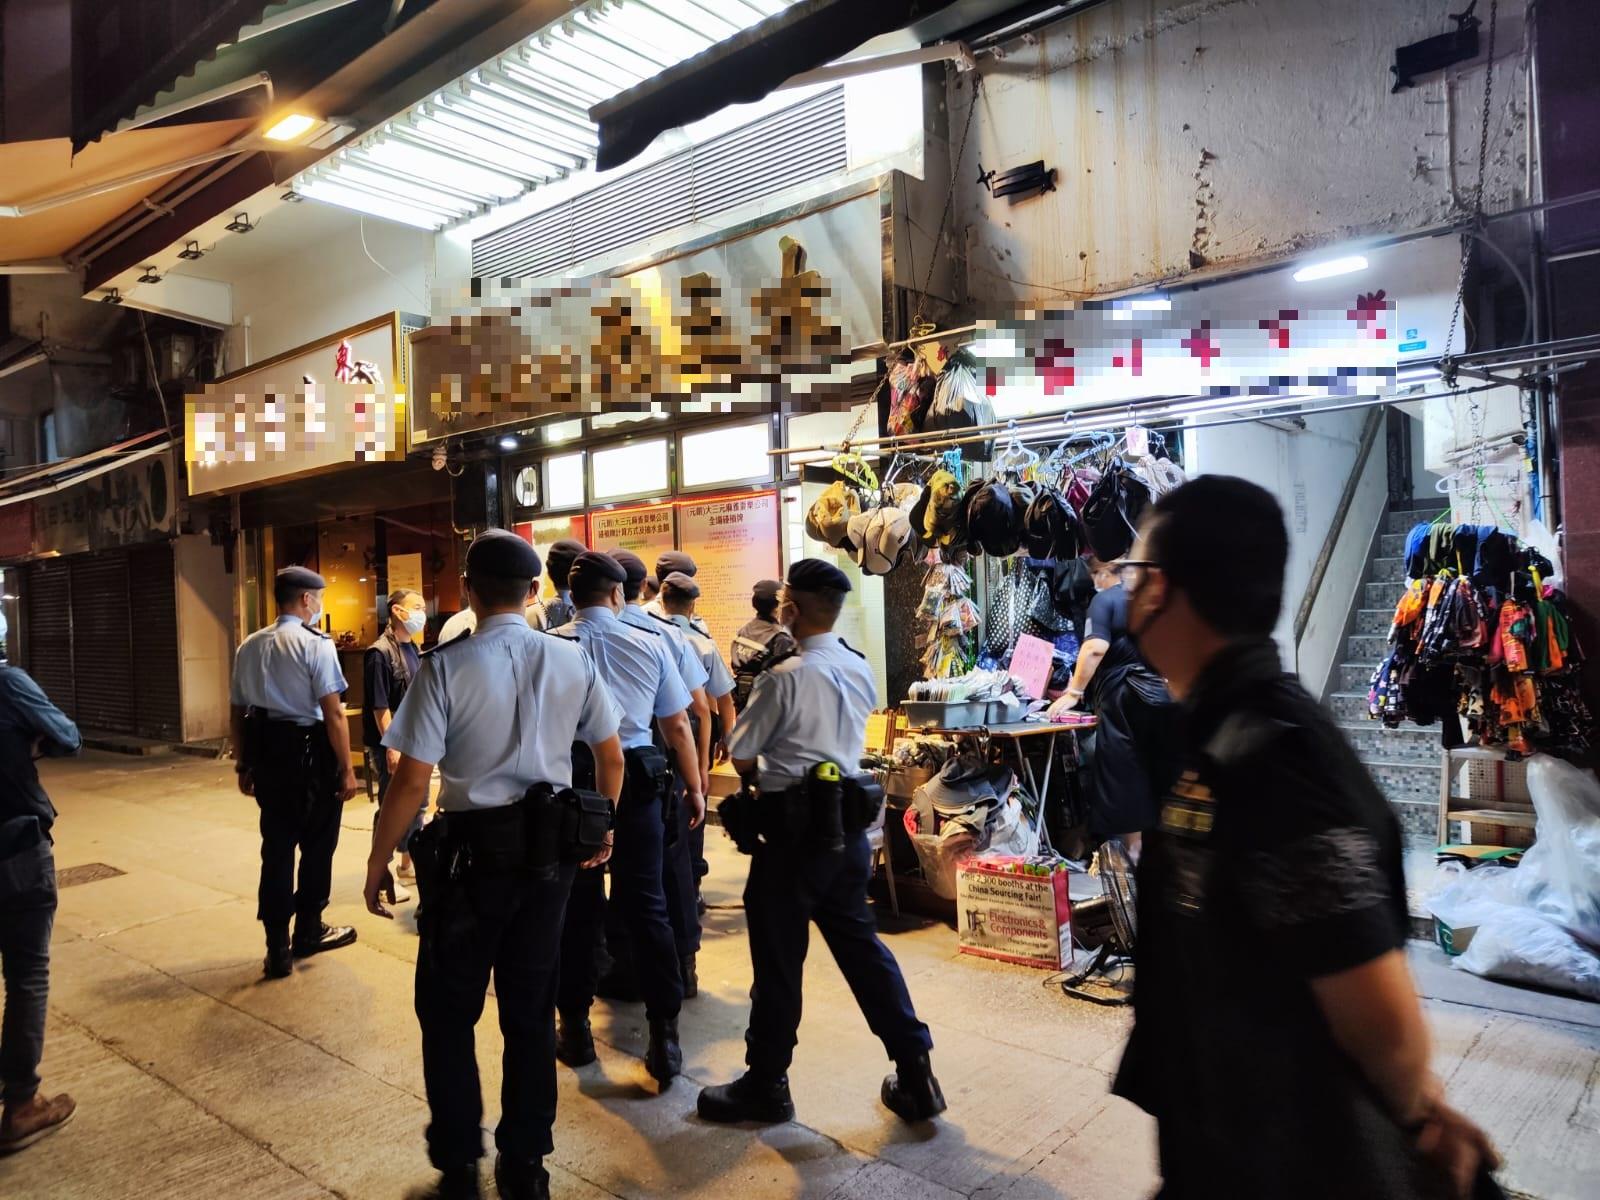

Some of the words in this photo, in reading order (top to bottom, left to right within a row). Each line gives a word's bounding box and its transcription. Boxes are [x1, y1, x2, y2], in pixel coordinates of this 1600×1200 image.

[968, 884, 989, 894] China
[990, 887, 1024, 901] Sourcing
[1024, 892, 1041, 902] Fair!
[998, 877, 1024, 889] booths
[1025, 882, 1033, 890] at
[1034, 883, 1049, 892] the
[990, 923, 1048, 940] Components
